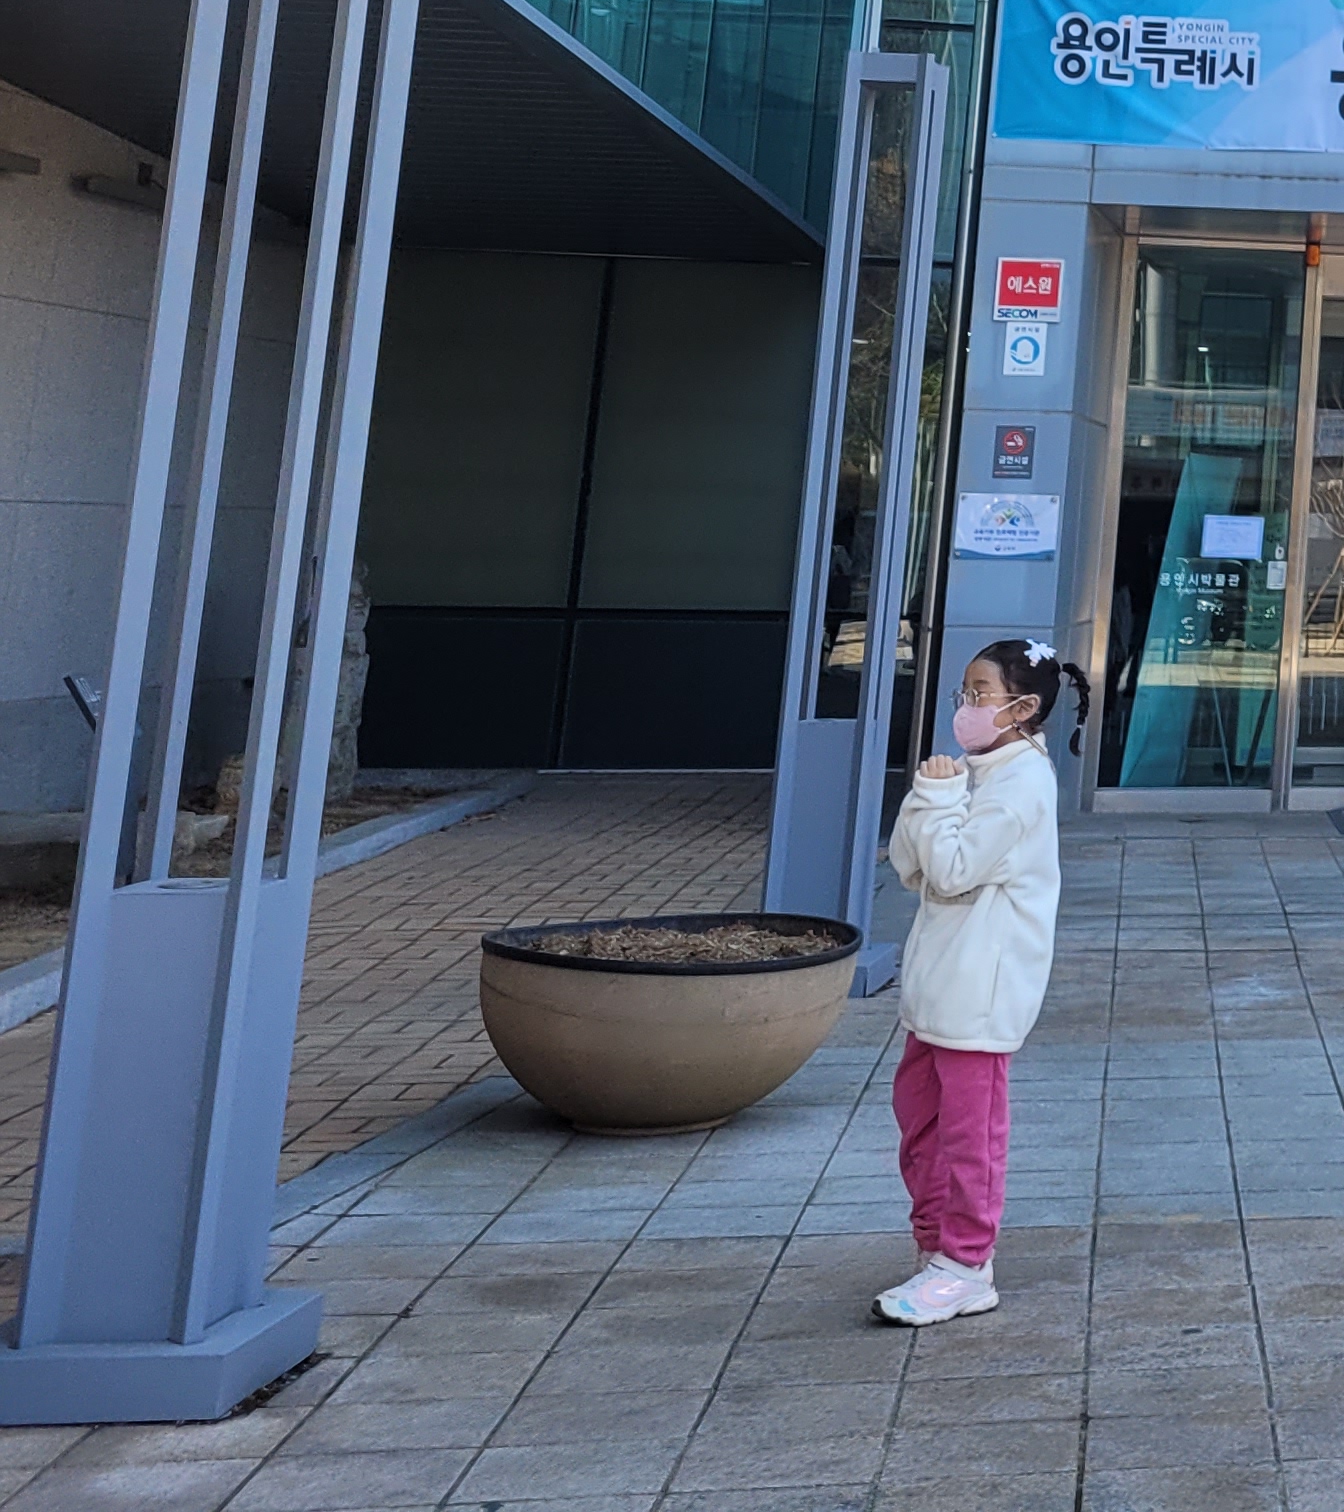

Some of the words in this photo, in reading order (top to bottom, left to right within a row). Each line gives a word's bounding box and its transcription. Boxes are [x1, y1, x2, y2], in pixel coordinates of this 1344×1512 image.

[1177, 22, 1225, 33] YONGIN
[1177, 34, 1223, 44] SPECIAL
[1228, 35, 1256, 45] CITY
[1055, 17, 1256, 86] 용인특례시
[1007, 275, 1053, 295] 에스원
[997, 308, 1039, 319] SECOM
[1160, 572, 1240, 587] 용인시박물관
